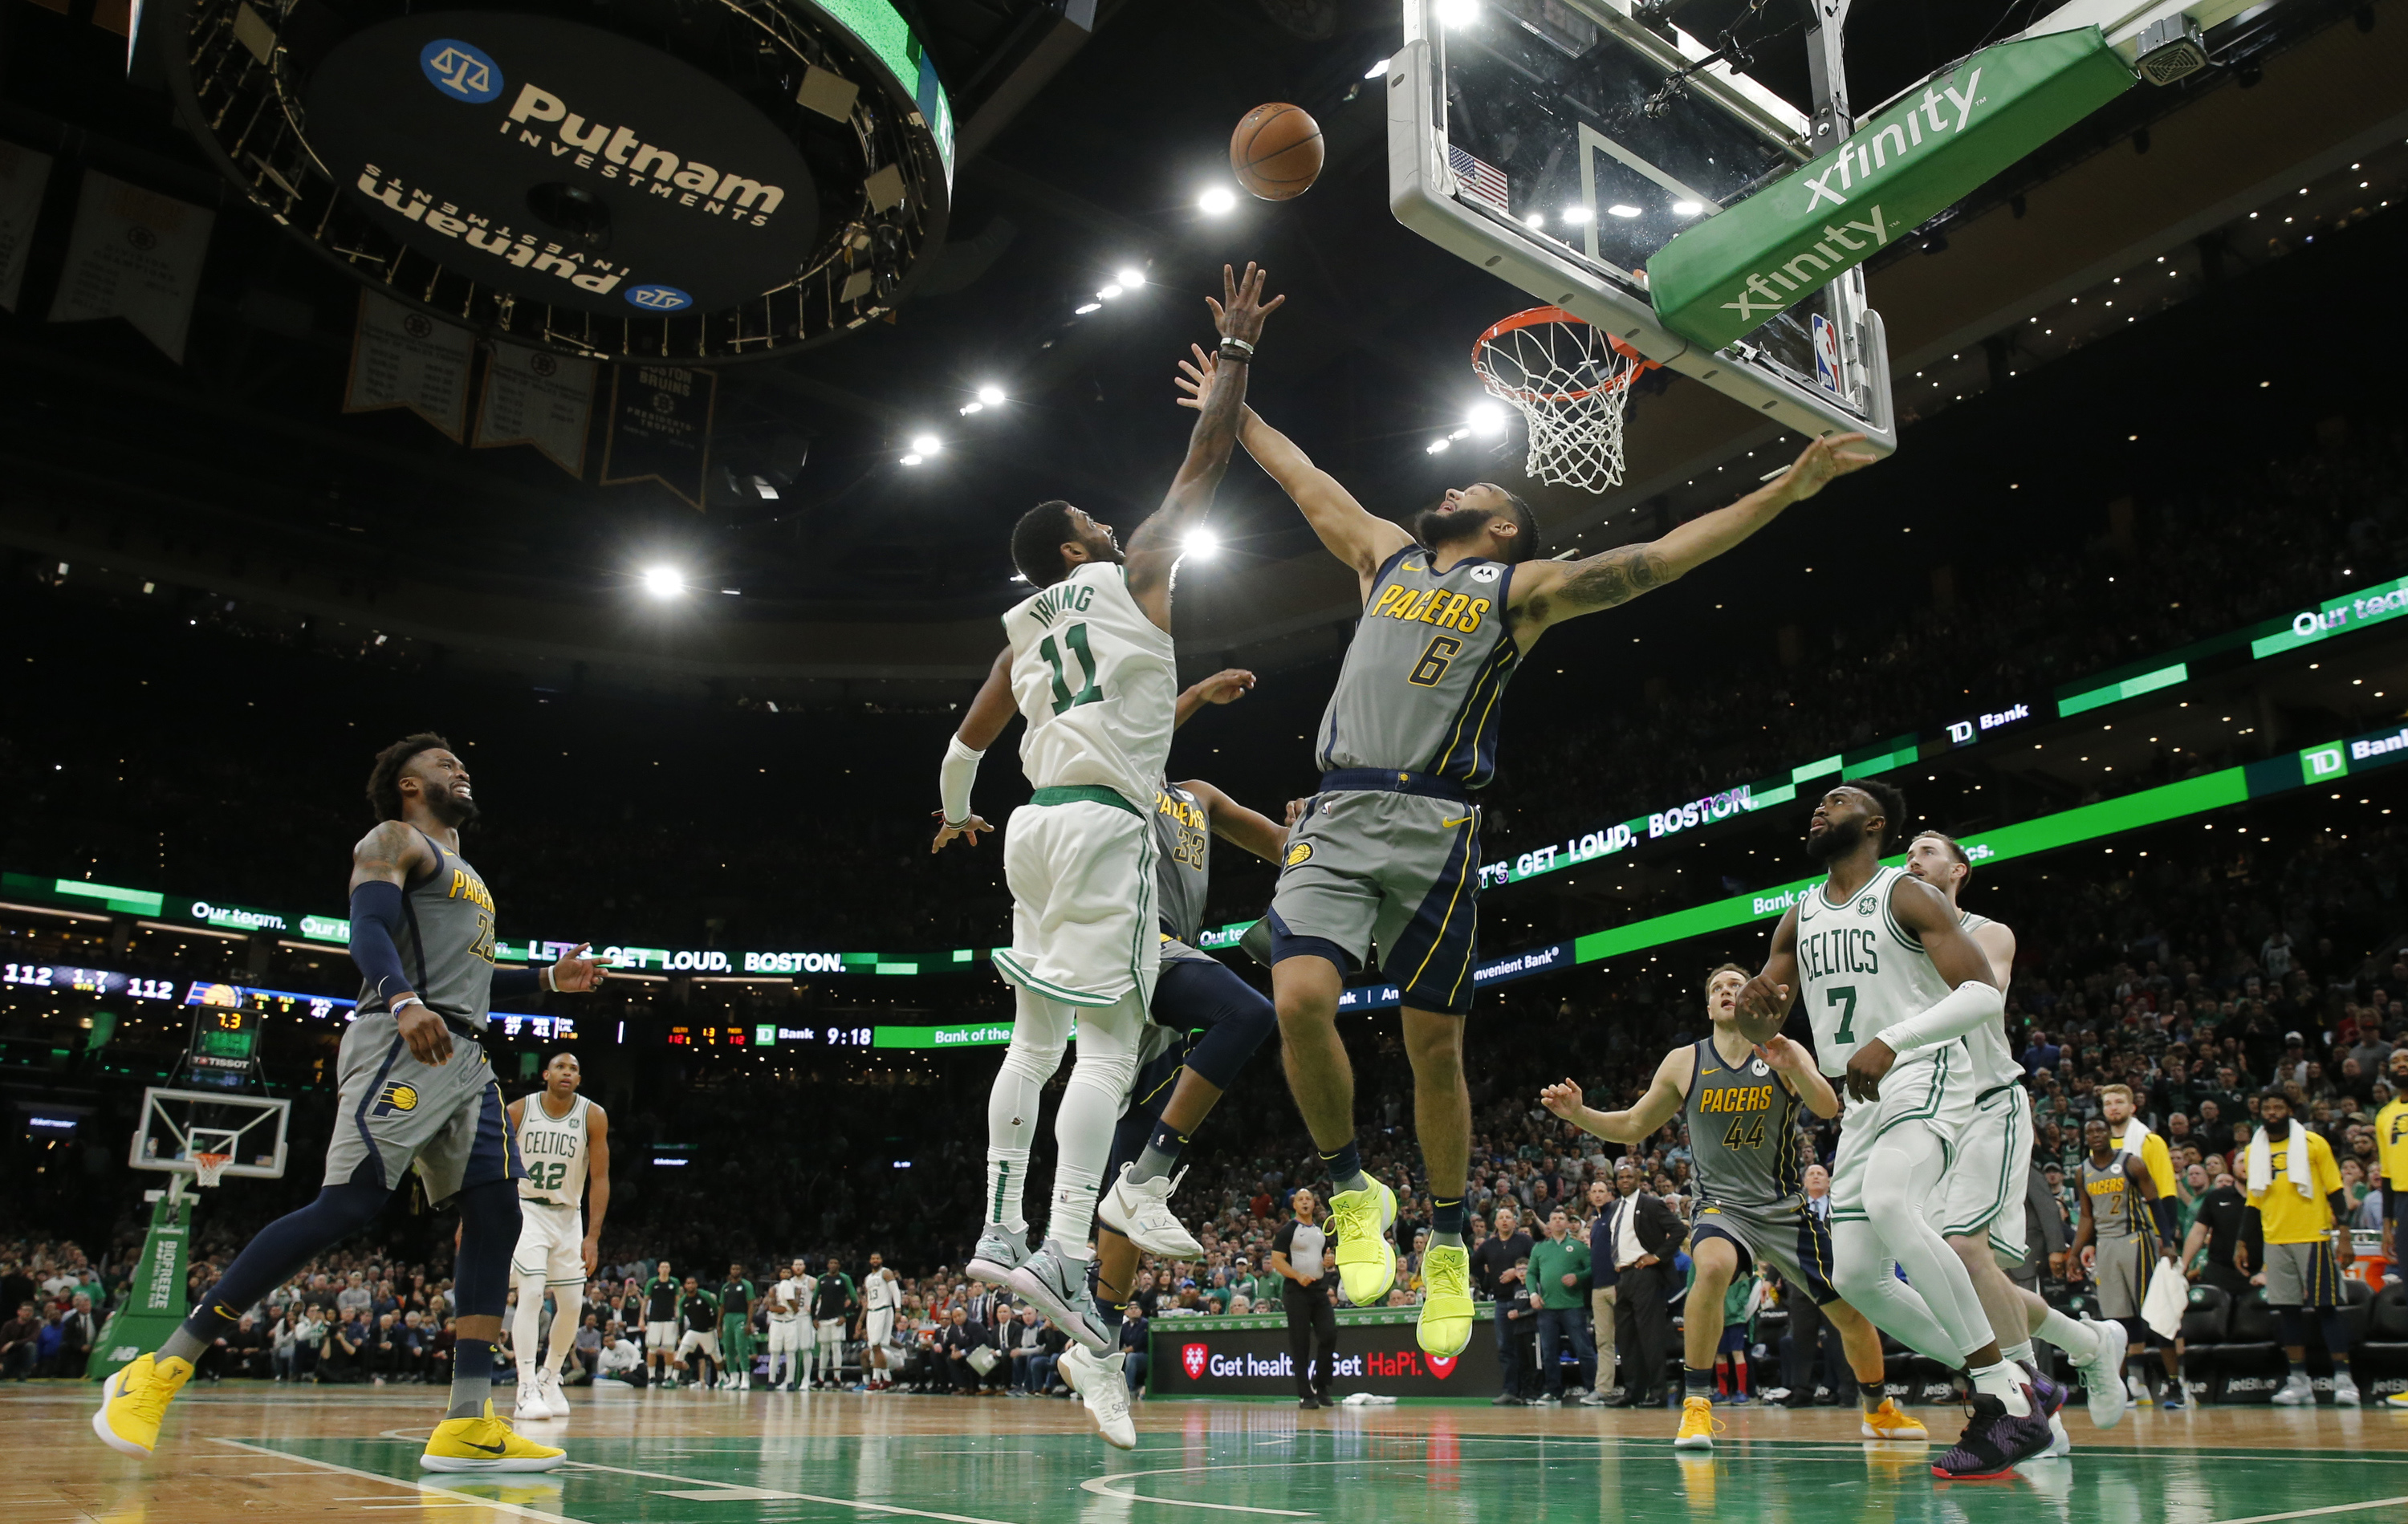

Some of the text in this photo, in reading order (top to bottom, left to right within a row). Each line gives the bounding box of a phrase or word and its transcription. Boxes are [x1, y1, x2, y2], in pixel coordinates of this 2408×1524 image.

[507, 83, 784, 217] Putnam
[1804, 67, 1981, 213] xfinity
[500, 120, 768, 228] INVESTMENTS
[357, 171, 621, 295] Putnam
[364, 162, 629, 275] INVESTMENTS
[1720, 204, 1892, 323] xfinity
[1028, 584, 1095, 628] IRVING
[1369, 583, 1491, 635] PACERS
[2292, 587, 2408, 636] Our tea
[1040, 623, 1104, 715] 11
[1407, 634, 1462, 688] 6
[1946, 703, 2029, 744] TD Bank
[2304, 748, 2343, 776] TD
[1516, 845, 1559, 877] GET
[1568, 824, 1637, 863] LOUD,
[1649, 785, 1759, 839] BOSTON.
[1173, 826, 1206, 872] 33
[449, 868, 495, 916] PACER
[1753, 892, 1795, 915] Bank
[191, 901, 287, 930] Our team.
[299, 916, 336, 938] Our
[1199, 929, 1227, 946] Our
[602, 945, 651, 969] GET
[662, 950, 732, 973] LOUD,
[744, 953, 846, 973] BOSTON.
[1474, 957, 1523, 981] nvenient
[1799, 928, 1878, 981] CELTICS
[3, 963, 174, 1001] 112 1.7 112
[96, 984, 107, 994] 4
[310, 1006, 331, 1019] 47
[1826, 986, 1857, 1045] 7
[503, 1023, 523, 1035] 27
[531, 1026, 551, 1038] 41
[729, 1035, 746, 1046] 112
[756, 1027, 872, 1046] TD Bank 9:18
[935, 1027, 1011, 1044] Bank of the
[208, 1057, 250, 1070] TISSOT
[1698, 1084, 1774, 1115] PACERS
[524, 1131, 577, 1159] CELTICS
[1723, 1115, 1766, 1152] 44
[527, 1160, 567, 1191] 42
[2087, 1177, 2125, 1196] PACERS
[2109, 1193, 2122, 1216] 2
[153, 1240, 178, 1310] BIOFREEZE
[1210, 1353, 1243, 1377] Get
[1247, 1352, 1317, 1380] healty.
[1367, 1351, 1423, 1377] HaPi.
[2227, 1377, 2278, 1395] jetBlue
